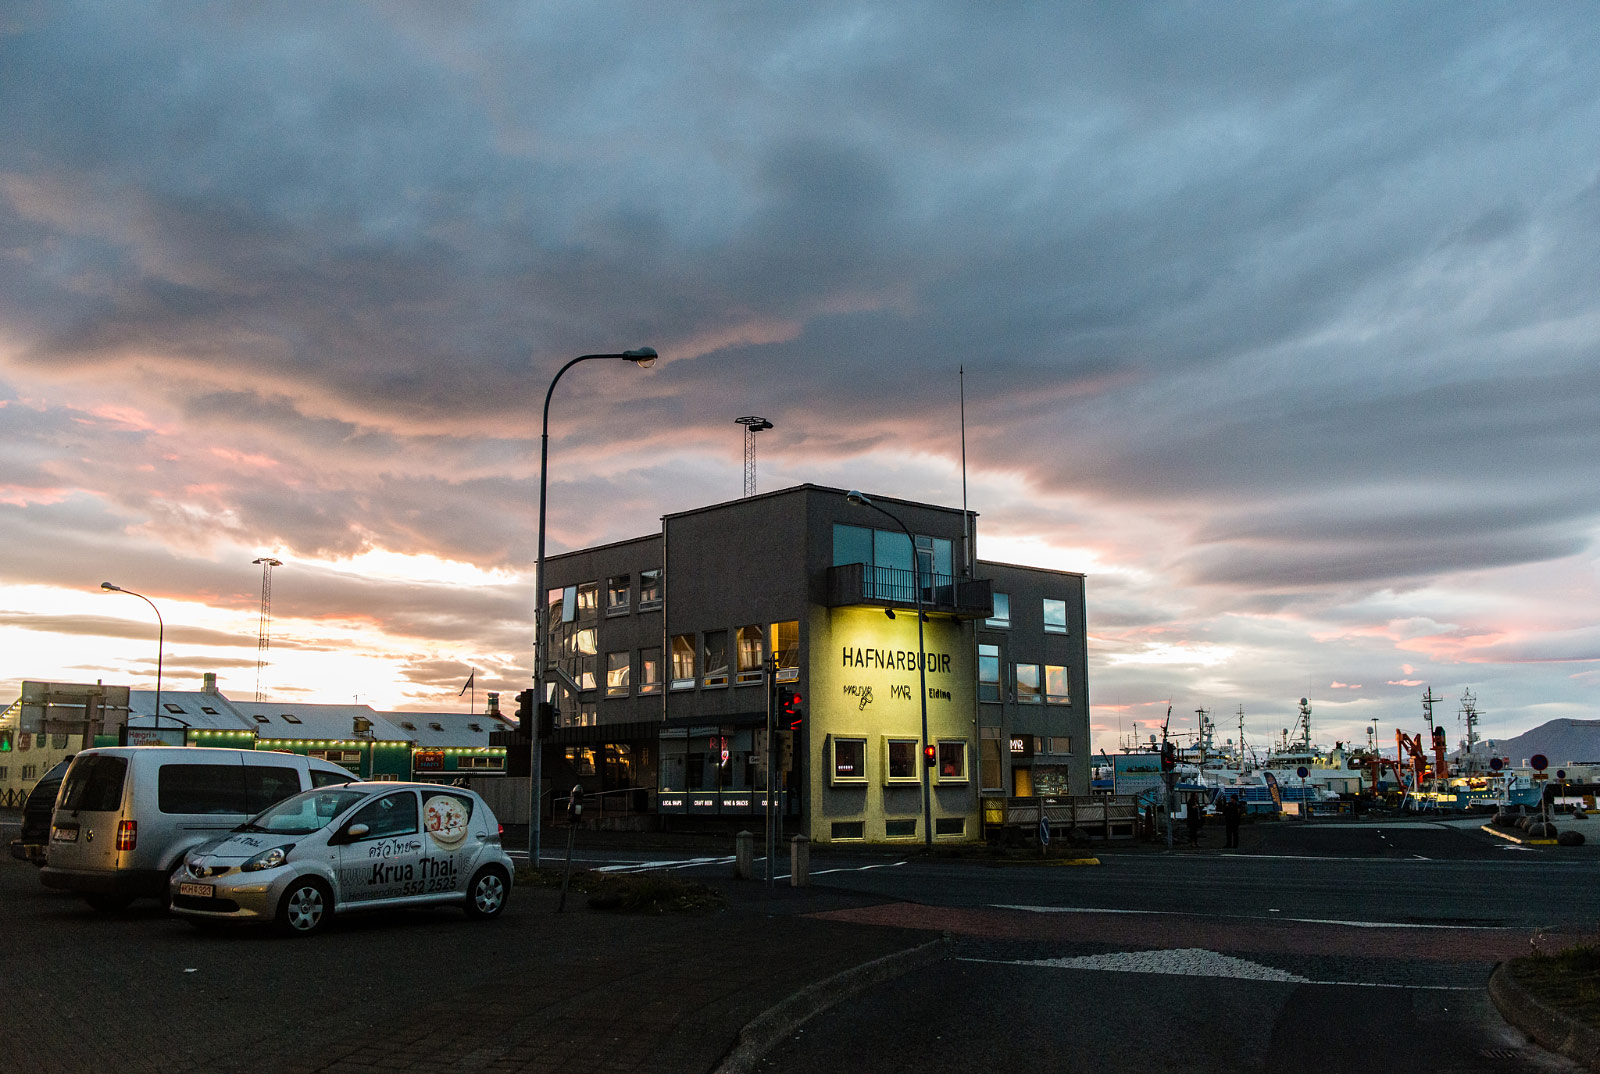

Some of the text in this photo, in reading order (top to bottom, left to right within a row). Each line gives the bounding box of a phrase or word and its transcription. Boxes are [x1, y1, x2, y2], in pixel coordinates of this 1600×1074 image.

[929, 688, 951, 702] Elding
[403, 881, 425, 895] 552
[427, 876, 458, 892] 2525
